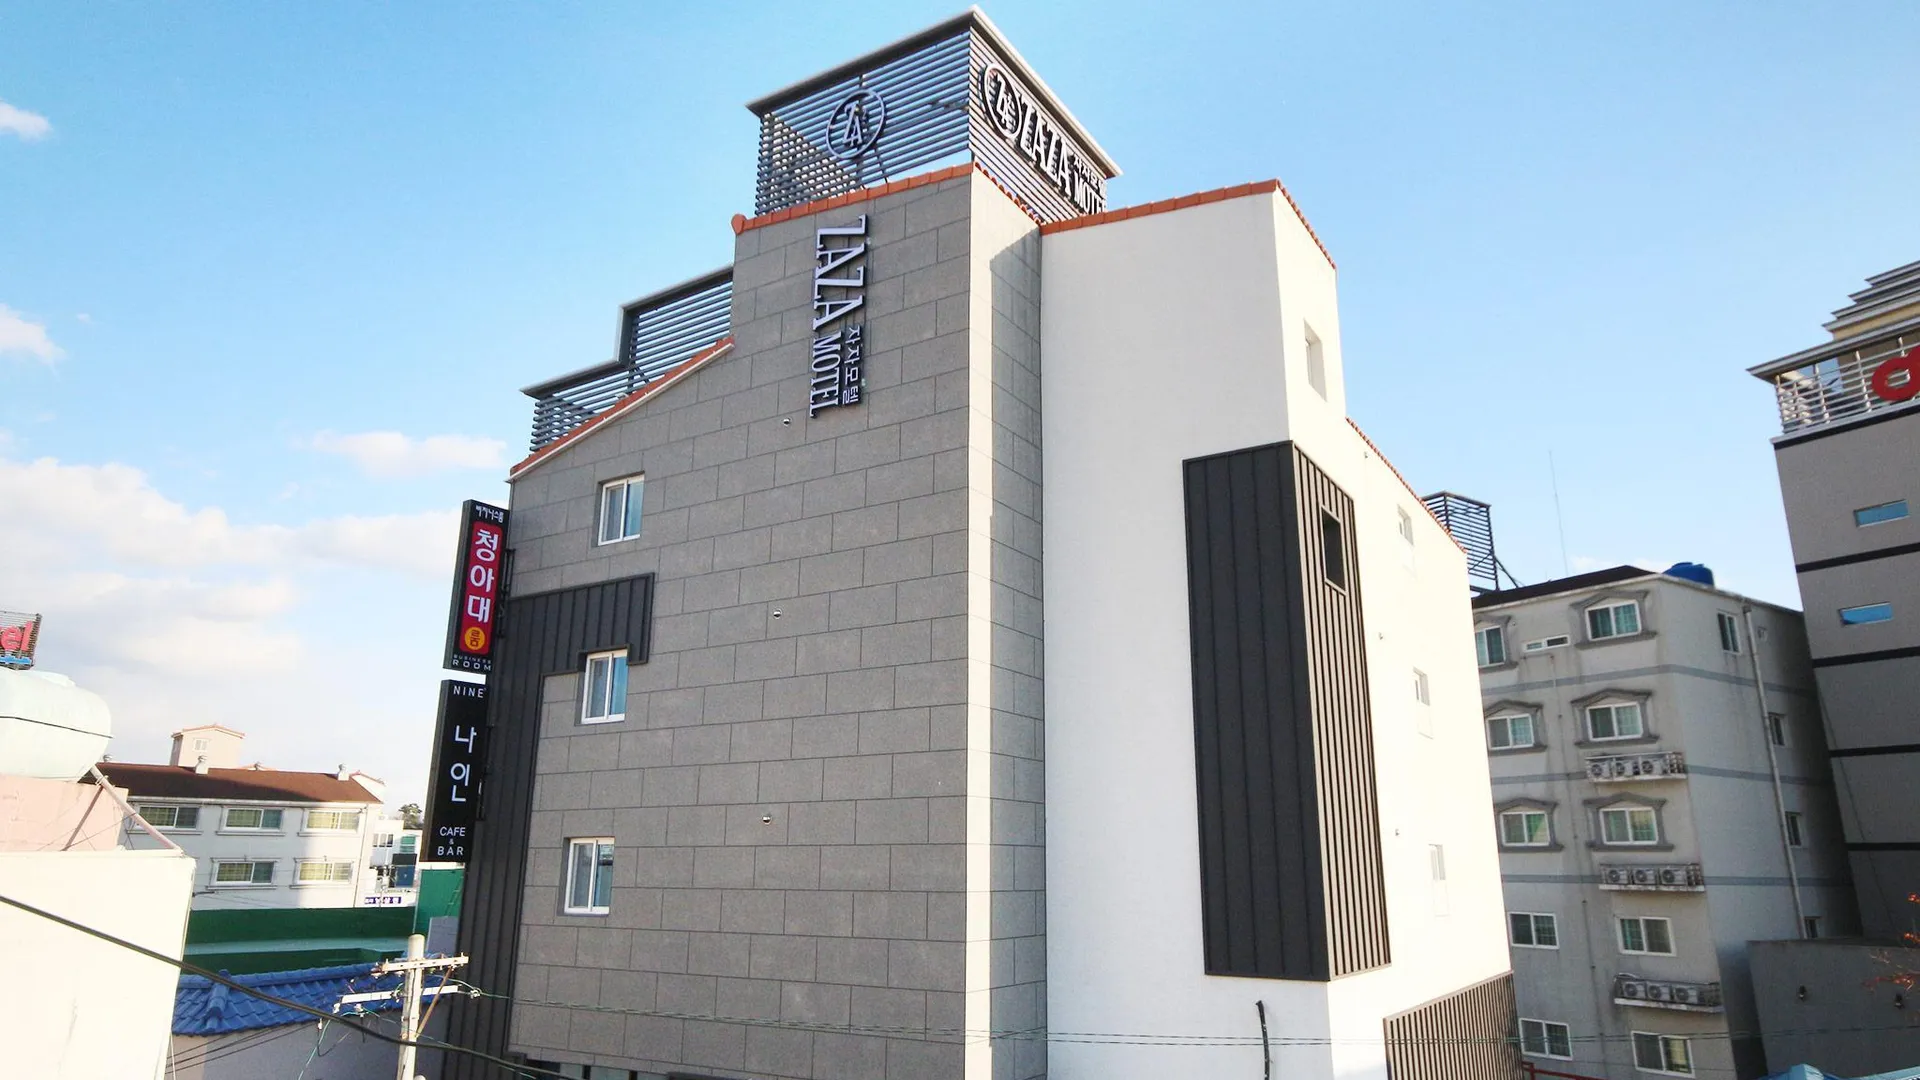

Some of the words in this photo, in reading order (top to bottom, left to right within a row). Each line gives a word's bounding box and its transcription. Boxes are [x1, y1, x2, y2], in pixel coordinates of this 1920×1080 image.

[813, 214, 867, 330] ZAZA
[809, 331, 842, 418] MOTEL
[843, 325, 861, 405] 자자모텔
[467, 529, 499, 623] 청아대
[452, 659, 492, 671] ROOM
[453, 654, 492, 664] BUSINESS
[453, 685, 484, 698] NINE
[450, 725, 477, 802] 나인
[437, 846, 464, 856] BAR
[439, 826, 466, 837] CAFE
